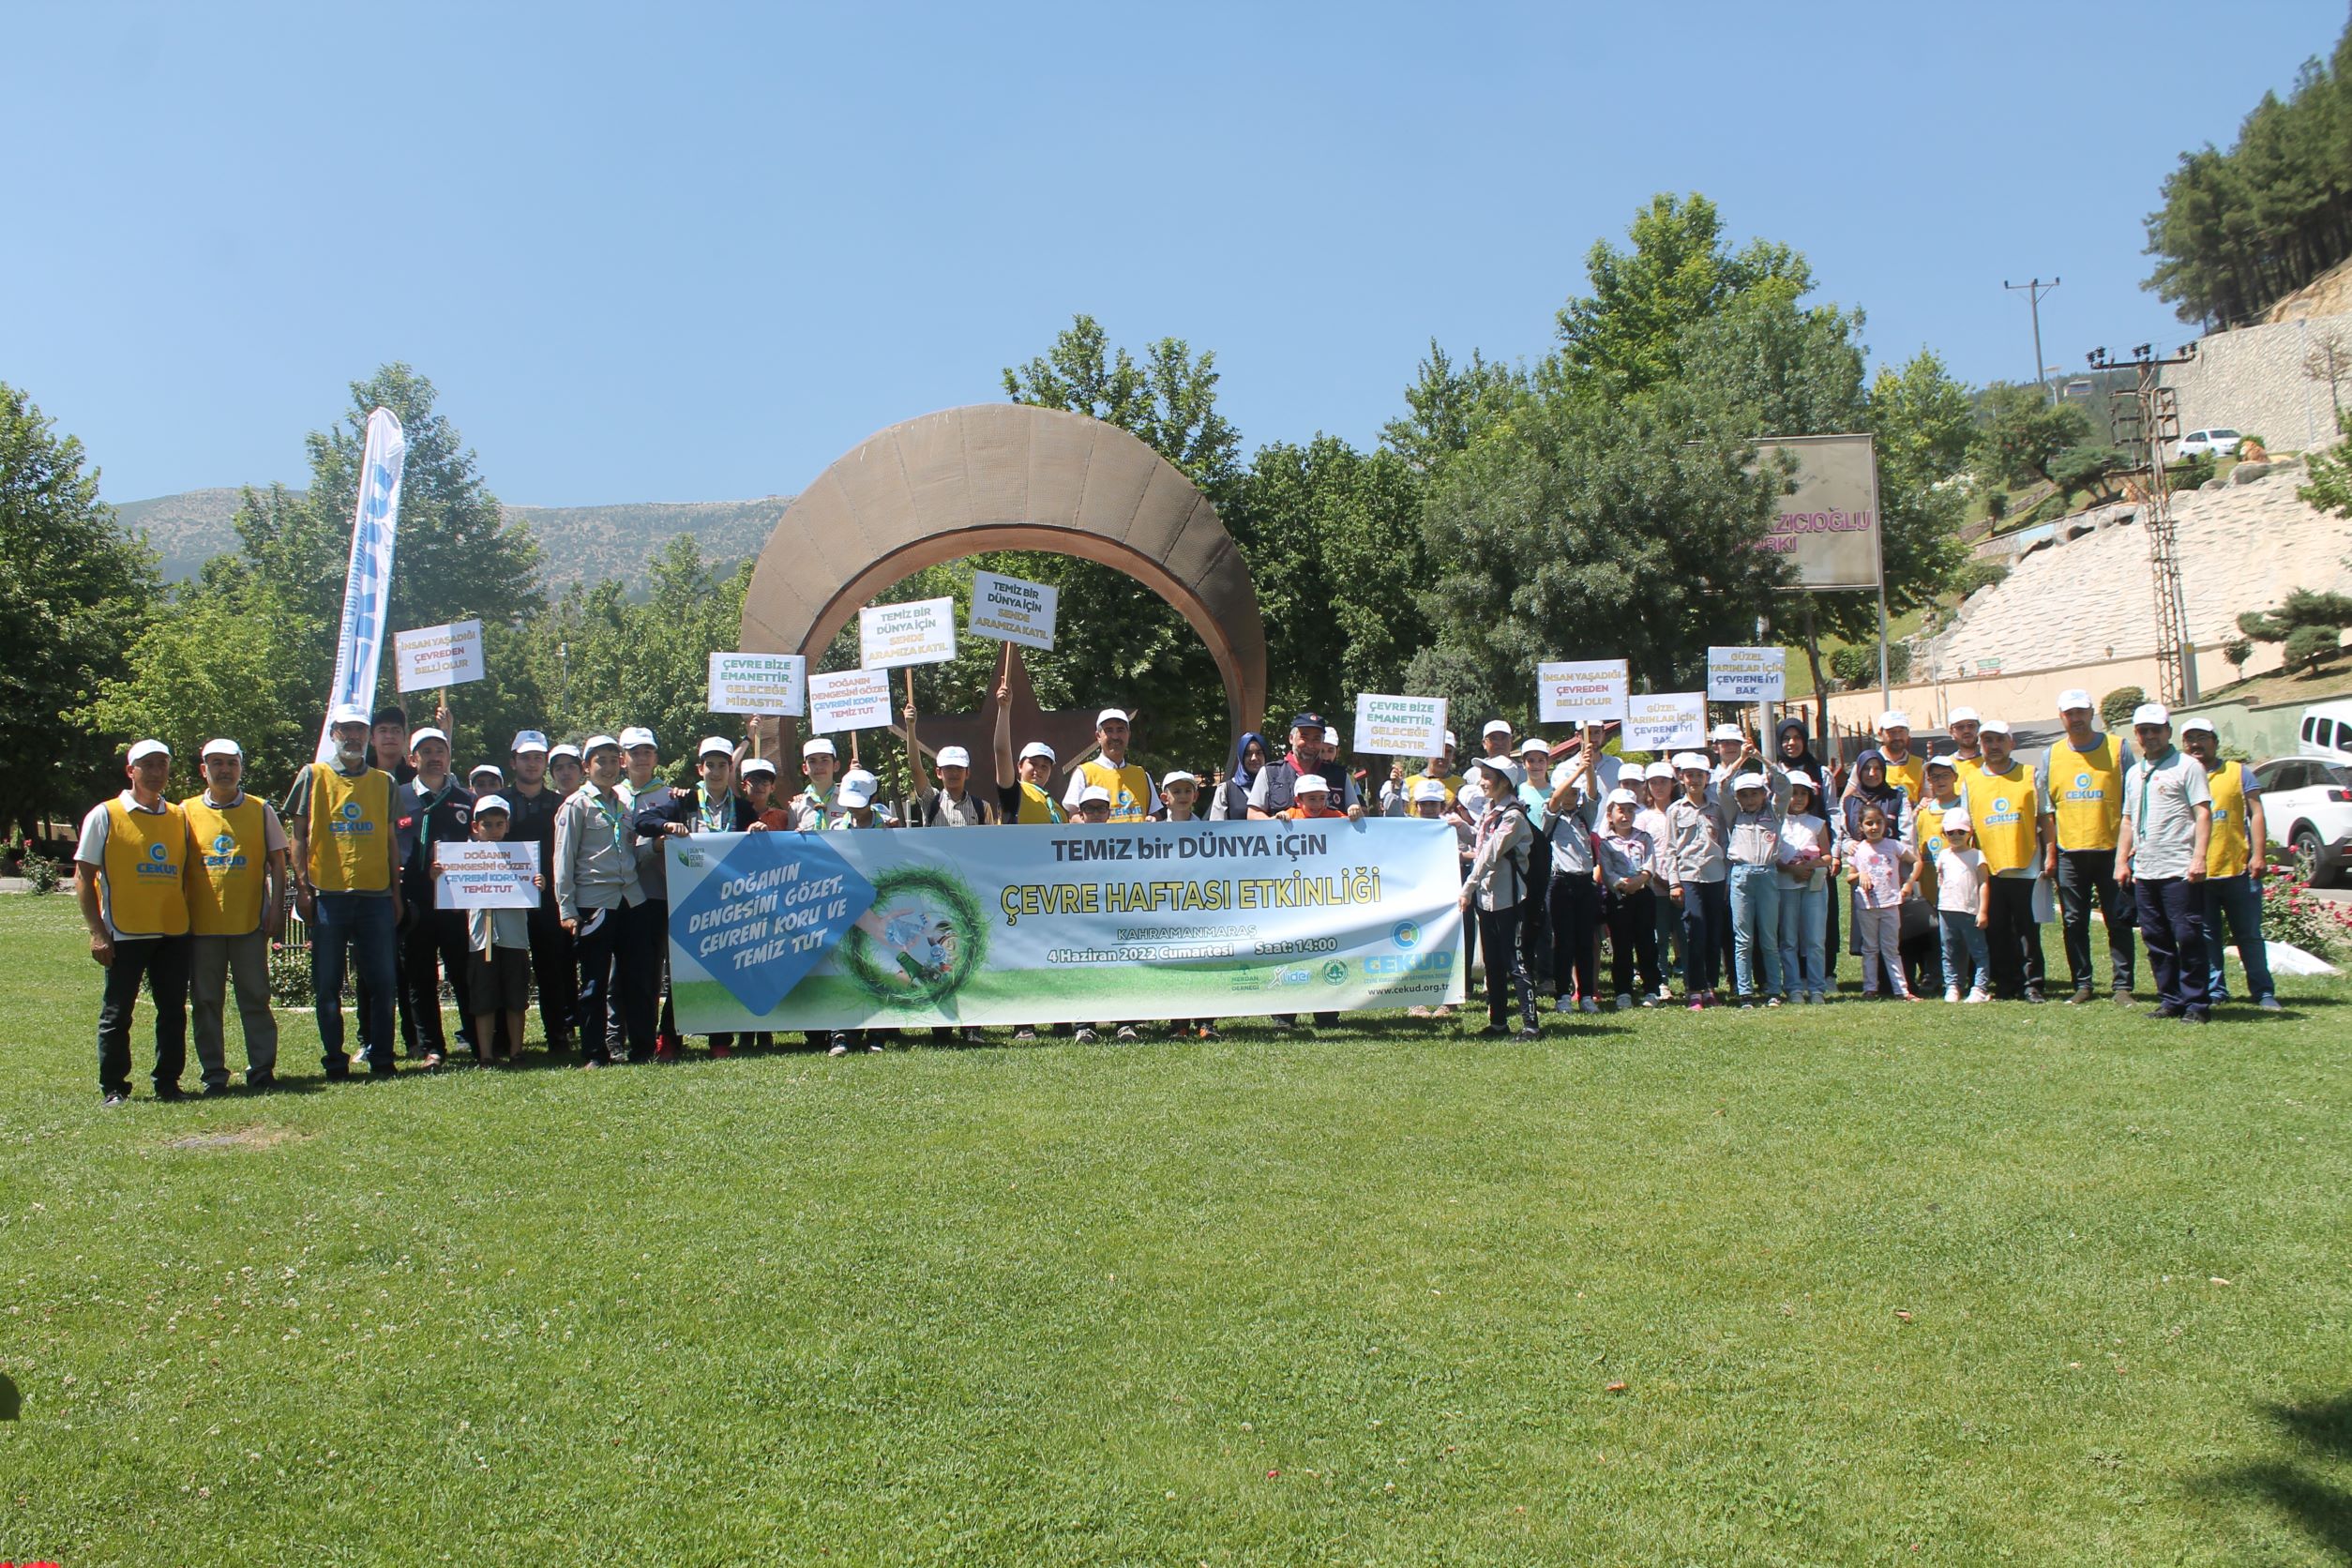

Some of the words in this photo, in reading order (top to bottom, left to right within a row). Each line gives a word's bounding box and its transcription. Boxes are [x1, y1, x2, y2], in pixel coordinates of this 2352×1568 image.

[1769, 507, 1871, 532] ZICIOĞLU
[993, 581, 1021, 596] TEMİZ
[1023, 588, 1039, 599] BİR
[988, 593, 1021, 608] DÜNYA
[1023, 599, 1041, 612] İÇİN
[881, 609, 912, 622] TEMİZ
[913, 607, 931, 617] BİR
[877, 622, 914, 635] DÜNYA
[915, 618, 936, 631] İÇİN
[415, 646, 465, 663] ÇEVREDEN
[443, 659, 469, 670] OLUR
[722, 659, 761, 671] ÇEVRE
[765, 659, 792, 670] BİZE
[829, 677, 870, 688] DOĞANIN
[1716, 675, 1763, 685] ÇEVRENE
[1765, 673, 1778, 683] İYİ
[726, 684, 788, 696] GELECEĞE
[1557, 685, 1609, 696] ÇEVREDEN
[814, 698, 852, 712] ÇEVRENİ
[853, 696, 878, 705] KORU
[1369, 701, 1407, 712] ÇEVRE
[1409, 702, 1435, 713] BİZE
[1557, 697, 1583, 707] BELLİ
[830, 708, 857, 718] TEMİZ
[1370, 726, 1429, 737] GELECEĞE
[1634, 725, 1679, 736] ÇEVRENE
[1138, 837, 1173, 859] bir
[1178, 831, 1271, 859] DÜNYA
[464, 850, 510, 859] DOĞANIN
[443, 861, 496, 870] DENGESİNİ
[445, 872, 488, 885] ÇEVRENİ
[720, 862, 801, 900] DOĞANIN
[462, 883, 493, 893] TEMİZ
[1001, 883, 1099, 926] ÇEVRE
[1106, 880, 1230, 913] HAFTASI
[1238, 867, 1380, 910] ETKİNLİĞİ
[688, 891, 778, 934] DENGESİNİ
[700, 917, 768, 958] ÇEVRENİ
[774, 905, 820, 934] KORU
[827, 898, 848, 920] VE
[1117, 925, 1257, 941] KAHRAMANMARAŞ
[732, 938, 786, 971] TEMİZ
[792, 927, 828, 954] TUT
[1047, 949, 1058, 963] 4
[1060, 947, 1117, 962] Haziran
[1120, 949, 1157, 962] 2022
[1159, 942, 1234, 960] Cumartesi
[1254, 942, 1294, 955] Saat:
[1295, 938, 1337, 953] 14:00
[1367, 983, 1450, 995] www.cekud.org.tr
